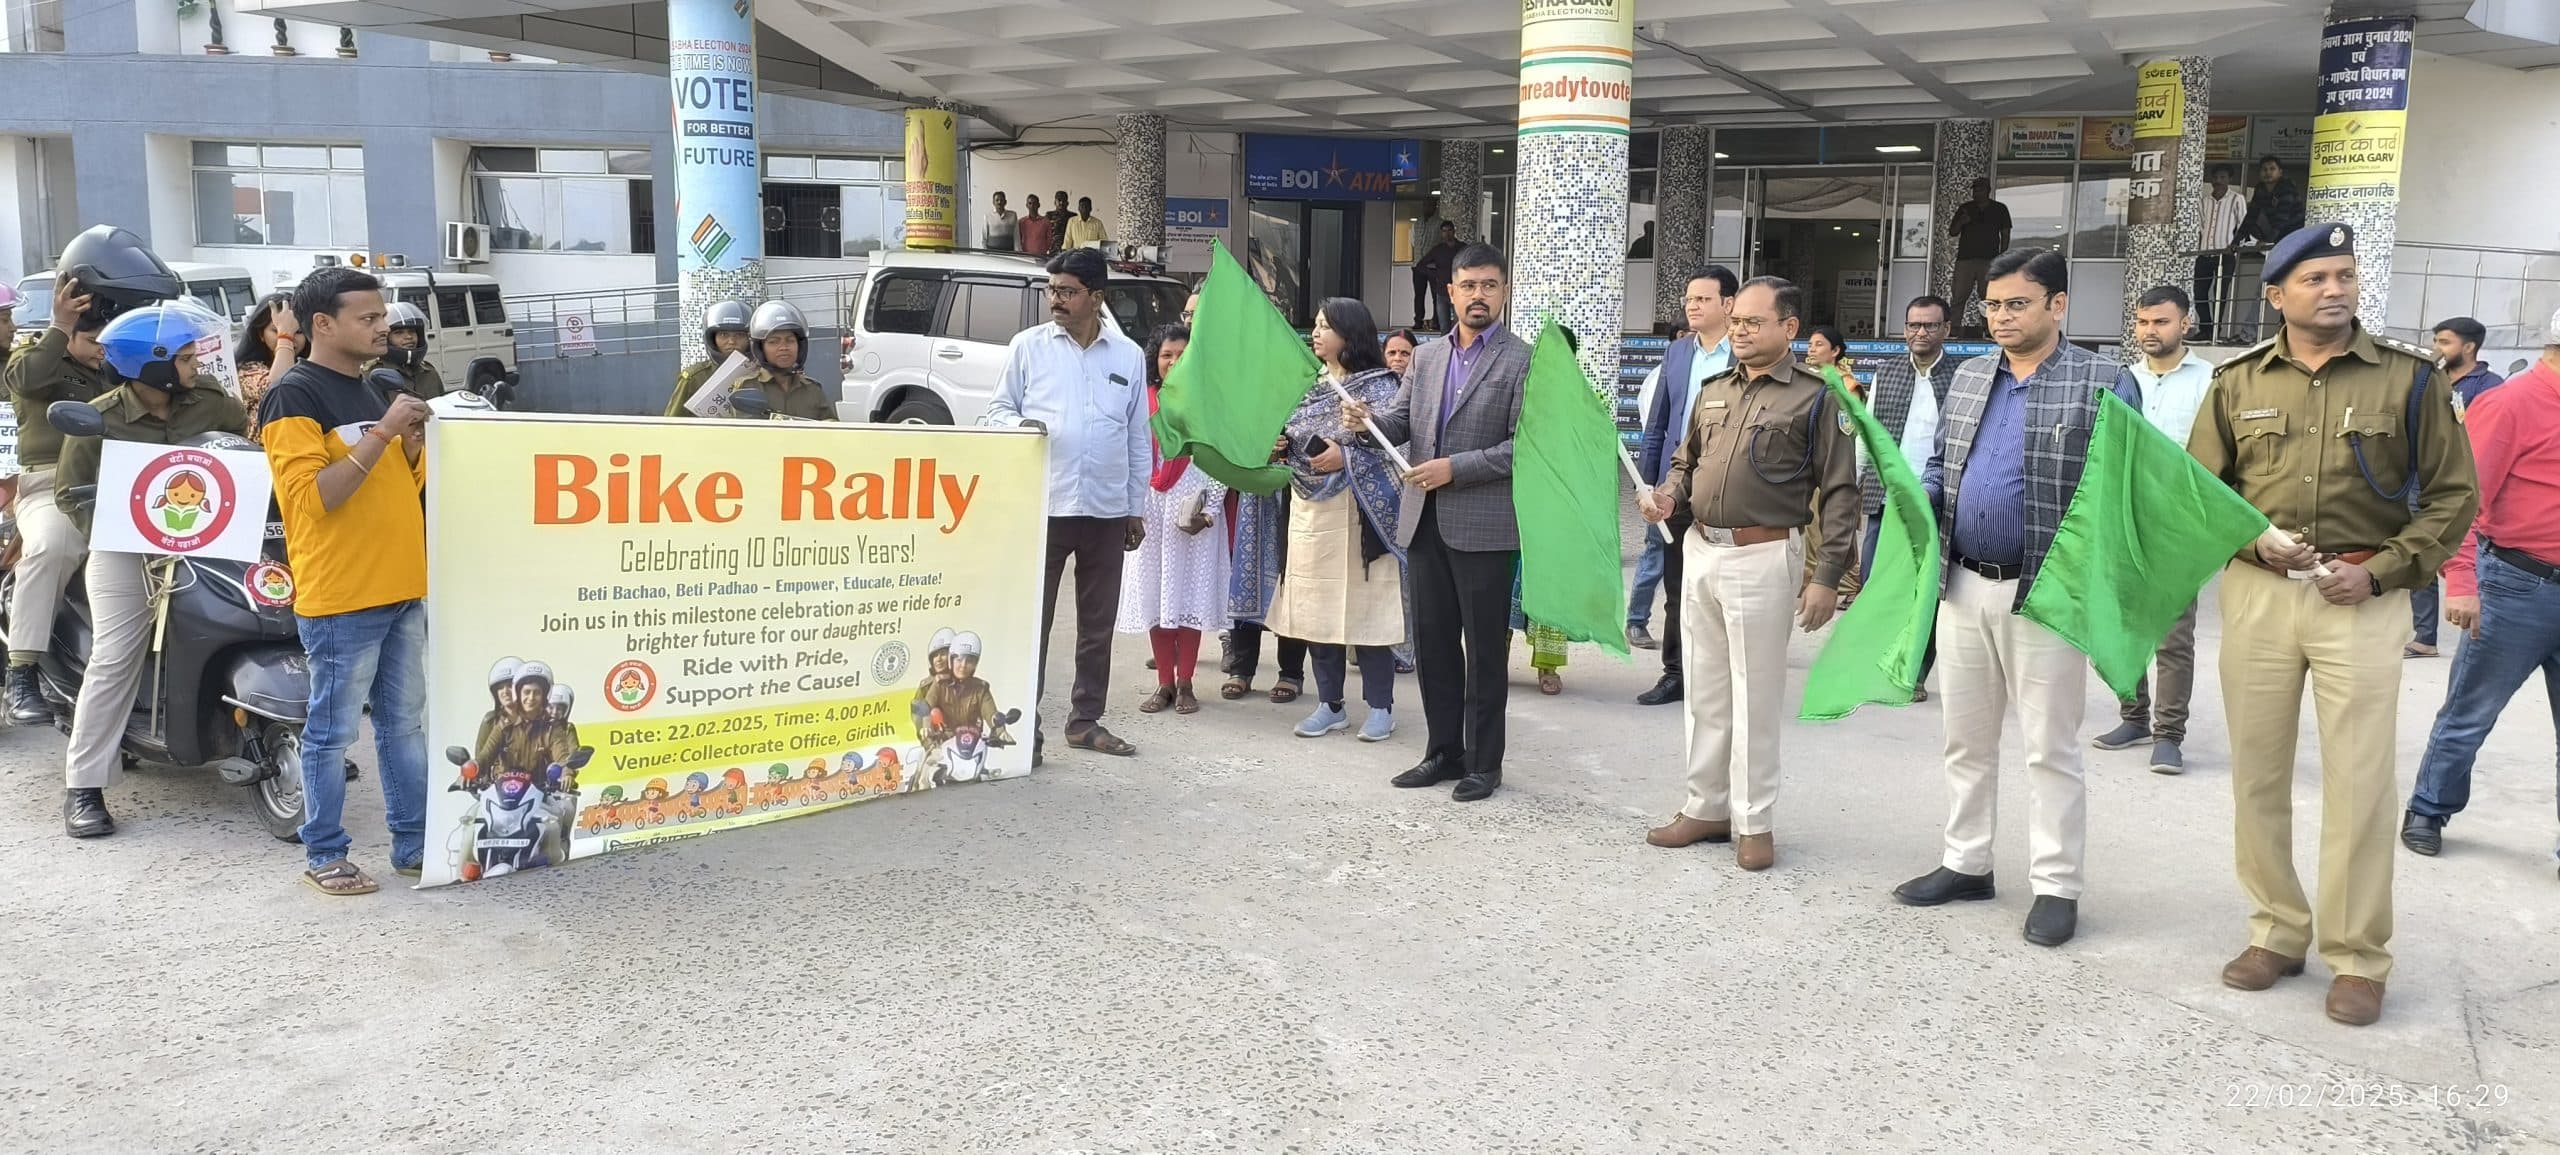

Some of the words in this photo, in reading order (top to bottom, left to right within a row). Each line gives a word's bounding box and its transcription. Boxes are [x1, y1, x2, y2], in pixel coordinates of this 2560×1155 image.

[1547, 8, 1591, 16] ELECTION
[1594, 8, 1614, 16] 2024
[694, 40, 736, 51] ELECTION
[2343, 33, 2363, 45] आम
[2365, 31, 2392, 47] चुनाव
[682, 53, 710, 70] TIME
[713, 54, 725, 71] IS
[2351, 47, 2367, 63] एवं
[2360, 66, 2390, 81] विधान
[675, 77, 754, 112] VOTE!
[2338, 89, 2364, 105] चुनाव
[2365, 87, 2393, 99] 2024
[687, 123, 708, 133] FOR
[710, 123, 750, 136] BETTER
[2314, 140, 2347, 160] चुनाव
[2350, 138, 2374, 150] का
[2377, 133, 2398, 150] पर्व
[684, 147, 755, 168] FUTURE
[2321, 154, 2346, 165] DESH
[2349, 154, 2364, 163] KA
[2367, 153, 2394, 162] GARV
[1281, 169, 1318, 189] BOI
[1350, 172, 1392, 192] ATM
[2351, 182, 2396, 198] नागरिक
[1178, 211, 1202, 223] BOI
[533, 453, 743, 524] Bike
[781, 457, 981, 534] Rally
[263, 526, 285, 537] 56
[620, 539, 739, 575] Celebrating
[747, 536, 765, 568] 10
[772, 536, 850, 567] Glorious
[856, 533, 915, 564] Years!
[578, 586, 608, 602] Beti
[613, 585, 671, 600] Bachao,
[676, 583, 703, 597] Beti
[708, 581, 758, 596] Padhao
[775, 579, 839, 595] Empower,
[843, 576, 895, 591] Educate,
[899, 572, 942, 587] Elevate!
[541, 612, 579, 632] Join
[586, 615, 606, 629] us
[611, 610, 628, 628] in
[634, 608, 666, 627] this
[672, 606, 756, 625] milestone
[761, 601, 854, 620] celebration
[858, 601, 873, 614] as
[877, 598, 899, 612] we
[902, 595, 929, 611] ride
[933, 593, 952, 609] for
[954, 594, 961, 606] a
[626, 631, 699, 654] brighter
[703, 629, 756, 647] future
[761, 626, 785, 644] for
[790, 627, 819, 642] our
[822, 617, 902, 640] daughters!
[683, 657, 733, 676] Ride
[740, 653, 788, 673] with
[795, 648, 849, 668] Pride,
[666, 682, 754, 707] Support
[760, 679, 791, 695] the
[797, 671, 860, 692] Cause!
[609, 729, 661, 746] Date:
[667, 714, 768, 741] 22.02.2025,
[775, 712, 820, 727] Time:
[825, 705, 858, 722] 4.00
[862, 700, 890, 717] P.M.
[613, 751, 677, 771] Venue:
[679, 738, 784, 764] Collectorate
[790, 732, 841, 751] Office,
[846, 721, 896, 742] Giridih
